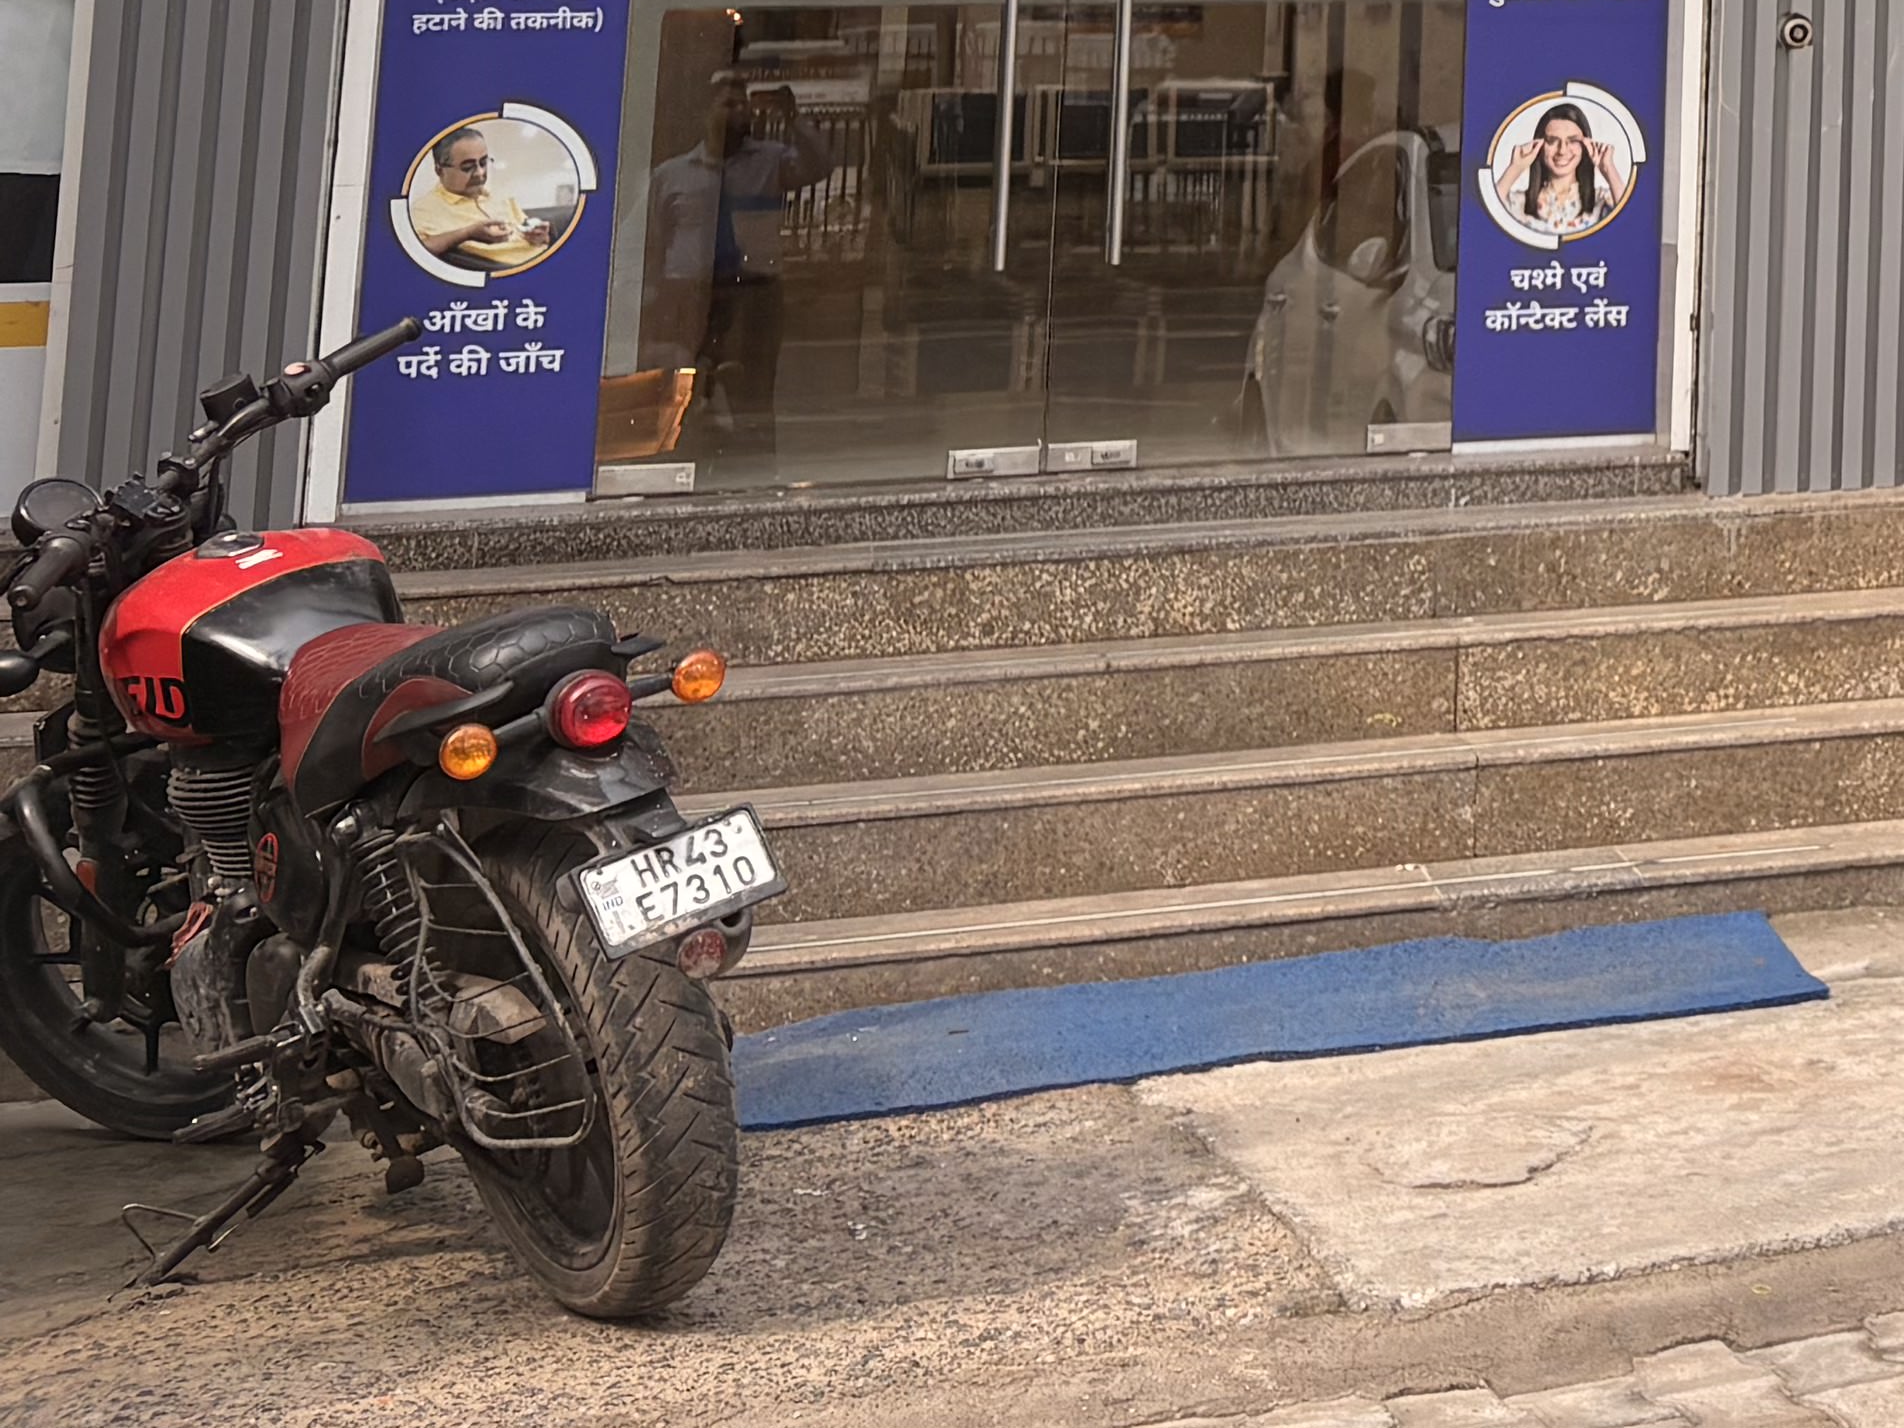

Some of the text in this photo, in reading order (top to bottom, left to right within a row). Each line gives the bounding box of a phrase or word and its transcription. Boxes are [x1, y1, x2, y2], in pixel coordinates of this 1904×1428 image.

[411, 6, 605, 36] हटाने की तकनीक)
[1511, 259, 1608, 293] चश्मे एवं
[423, 299, 546, 335] आँखों के
[1585, 298, 1628, 329] लेंस
[397, 338, 564, 380] पर्दे की जाँच
[636, 855, 756, 923] E7310
